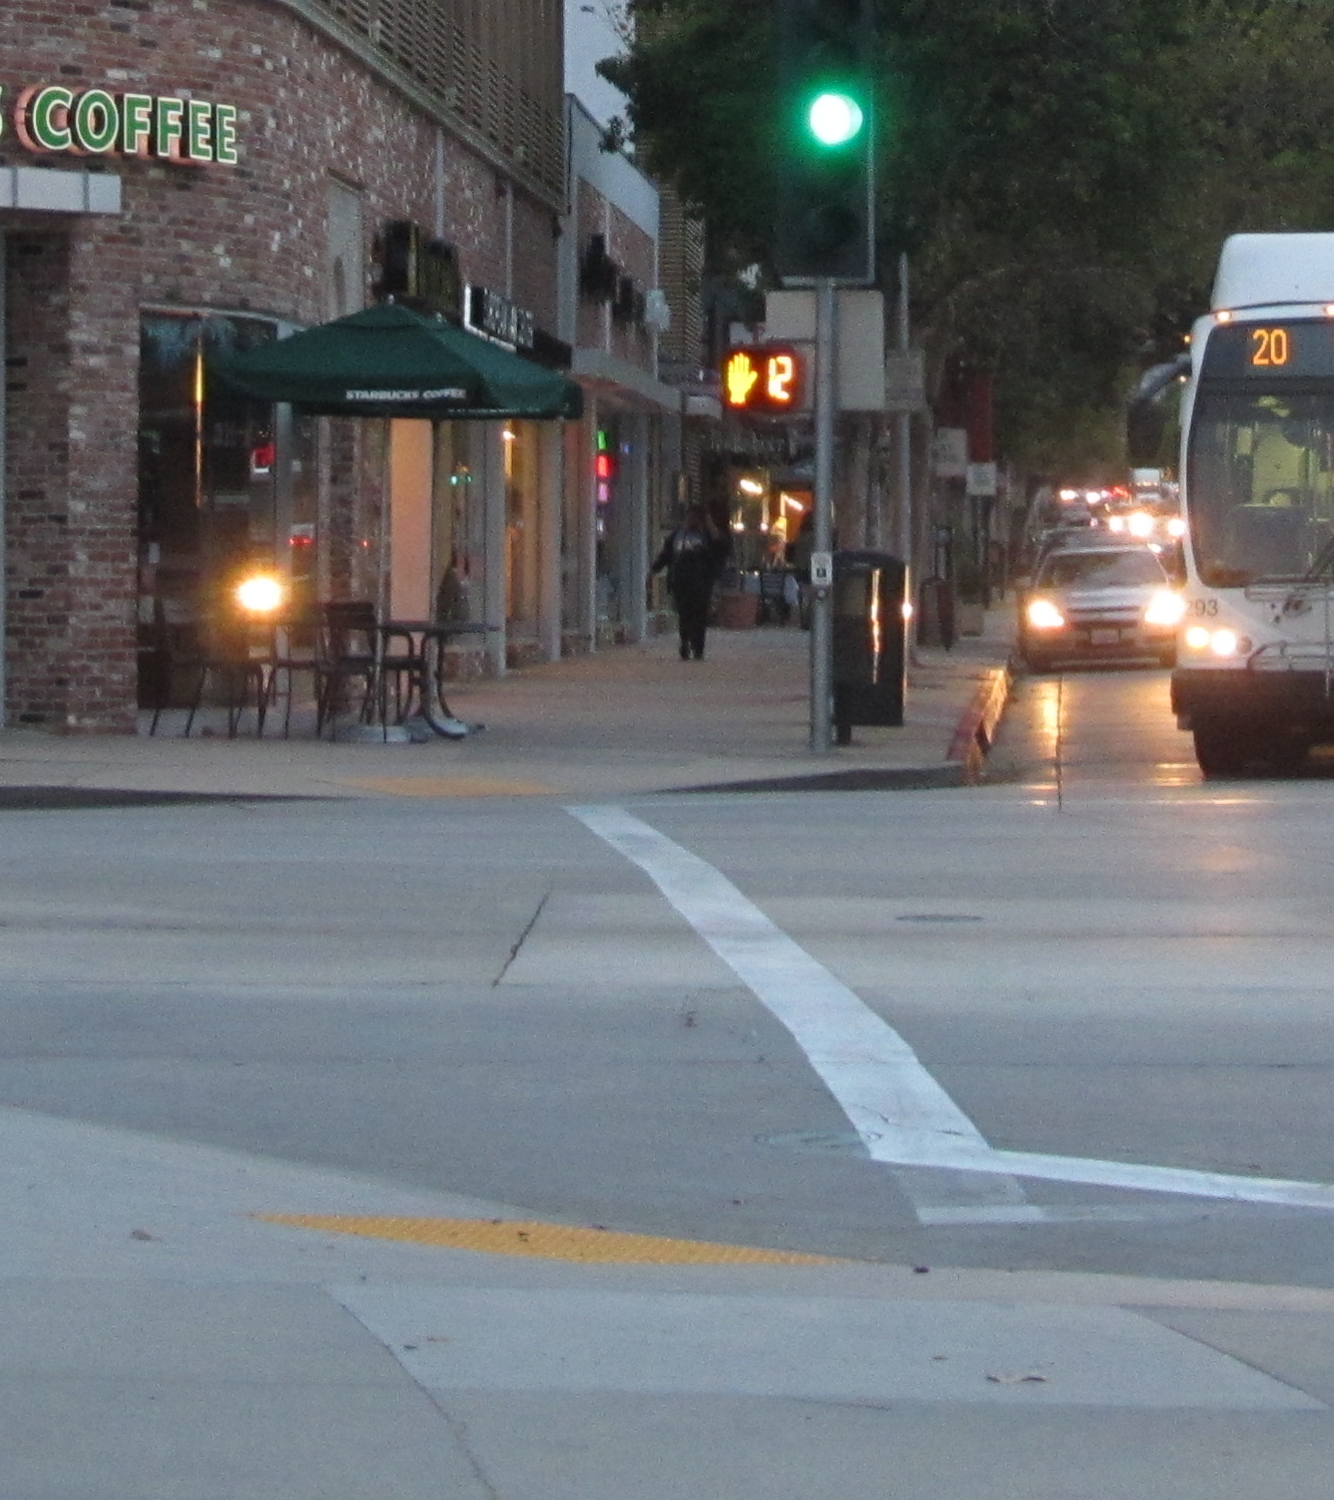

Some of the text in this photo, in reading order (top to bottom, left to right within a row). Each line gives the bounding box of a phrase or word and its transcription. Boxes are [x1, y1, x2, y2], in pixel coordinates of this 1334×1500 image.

[32, 85, 239, 165] COFFEE
[1252, 328, 1288, 366] 20
[346, 388, 466, 401] STARBUCKS COFFEE
[768, 355, 793, 400] 12
